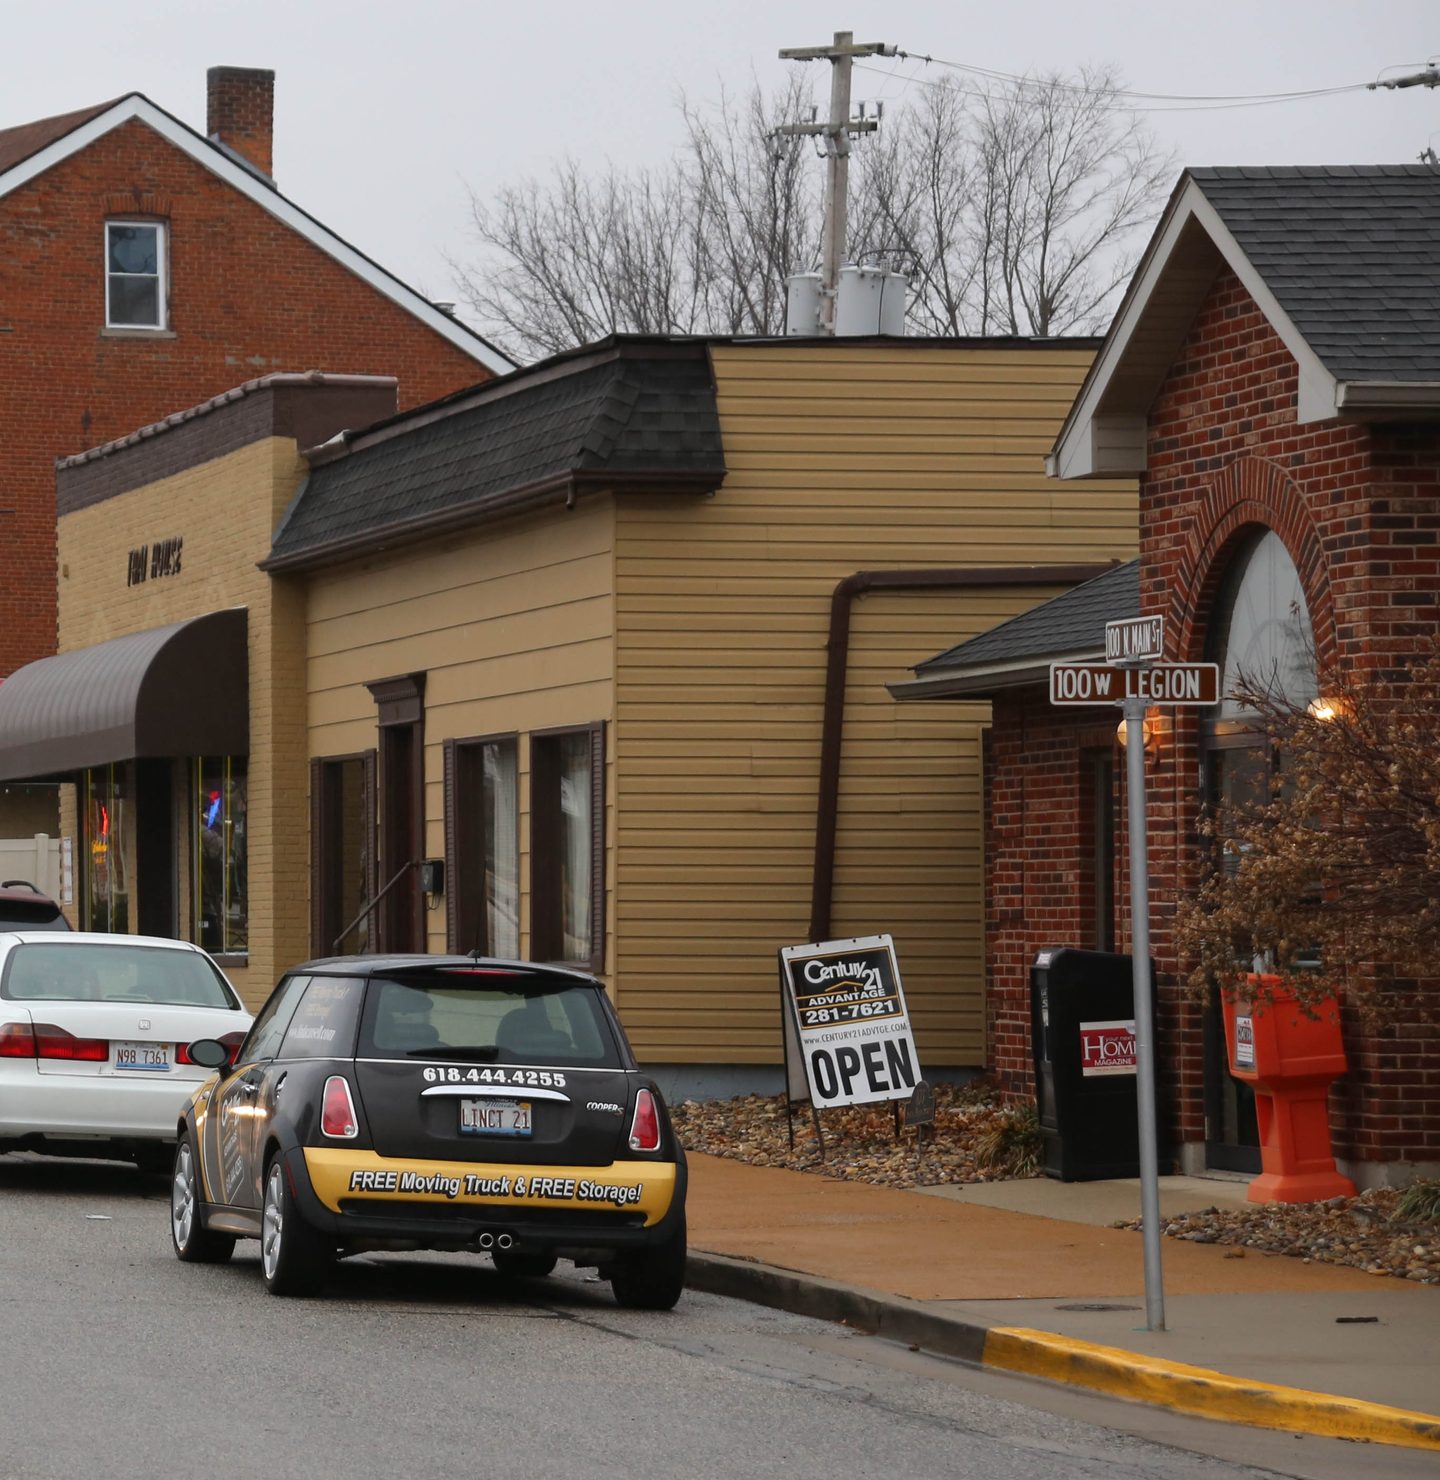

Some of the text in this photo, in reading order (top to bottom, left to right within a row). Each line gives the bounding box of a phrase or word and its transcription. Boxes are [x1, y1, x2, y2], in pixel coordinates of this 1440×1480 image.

[1107, 627, 1120, 656] 100
[1131, 623, 1151, 654] MAIN
[1125, 669, 1200, 699] LEGION
[804, 960, 866, 984] Century
[861, 968, 883, 991] 21
[809, 988, 886, 1006] ADVANTAGE
[806, 1000, 894, 1024] 281-7621
[117, 1049, 168, 1065] N98 7361
[1082, 1035, 1136, 1060] HOM
[811, 1038, 916, 1100] OPEN
[1094, 1058, 1133, 1066] MAGAZINE
[423, 1067, 567, 1088] 618.444.4255
[586, 1101, 619, 1112] COOPER
[462, 1108, 530, 1129] LINCT 21
[350, 1171, 643, 1205] FREE Moving Truck & FREE Storage!
